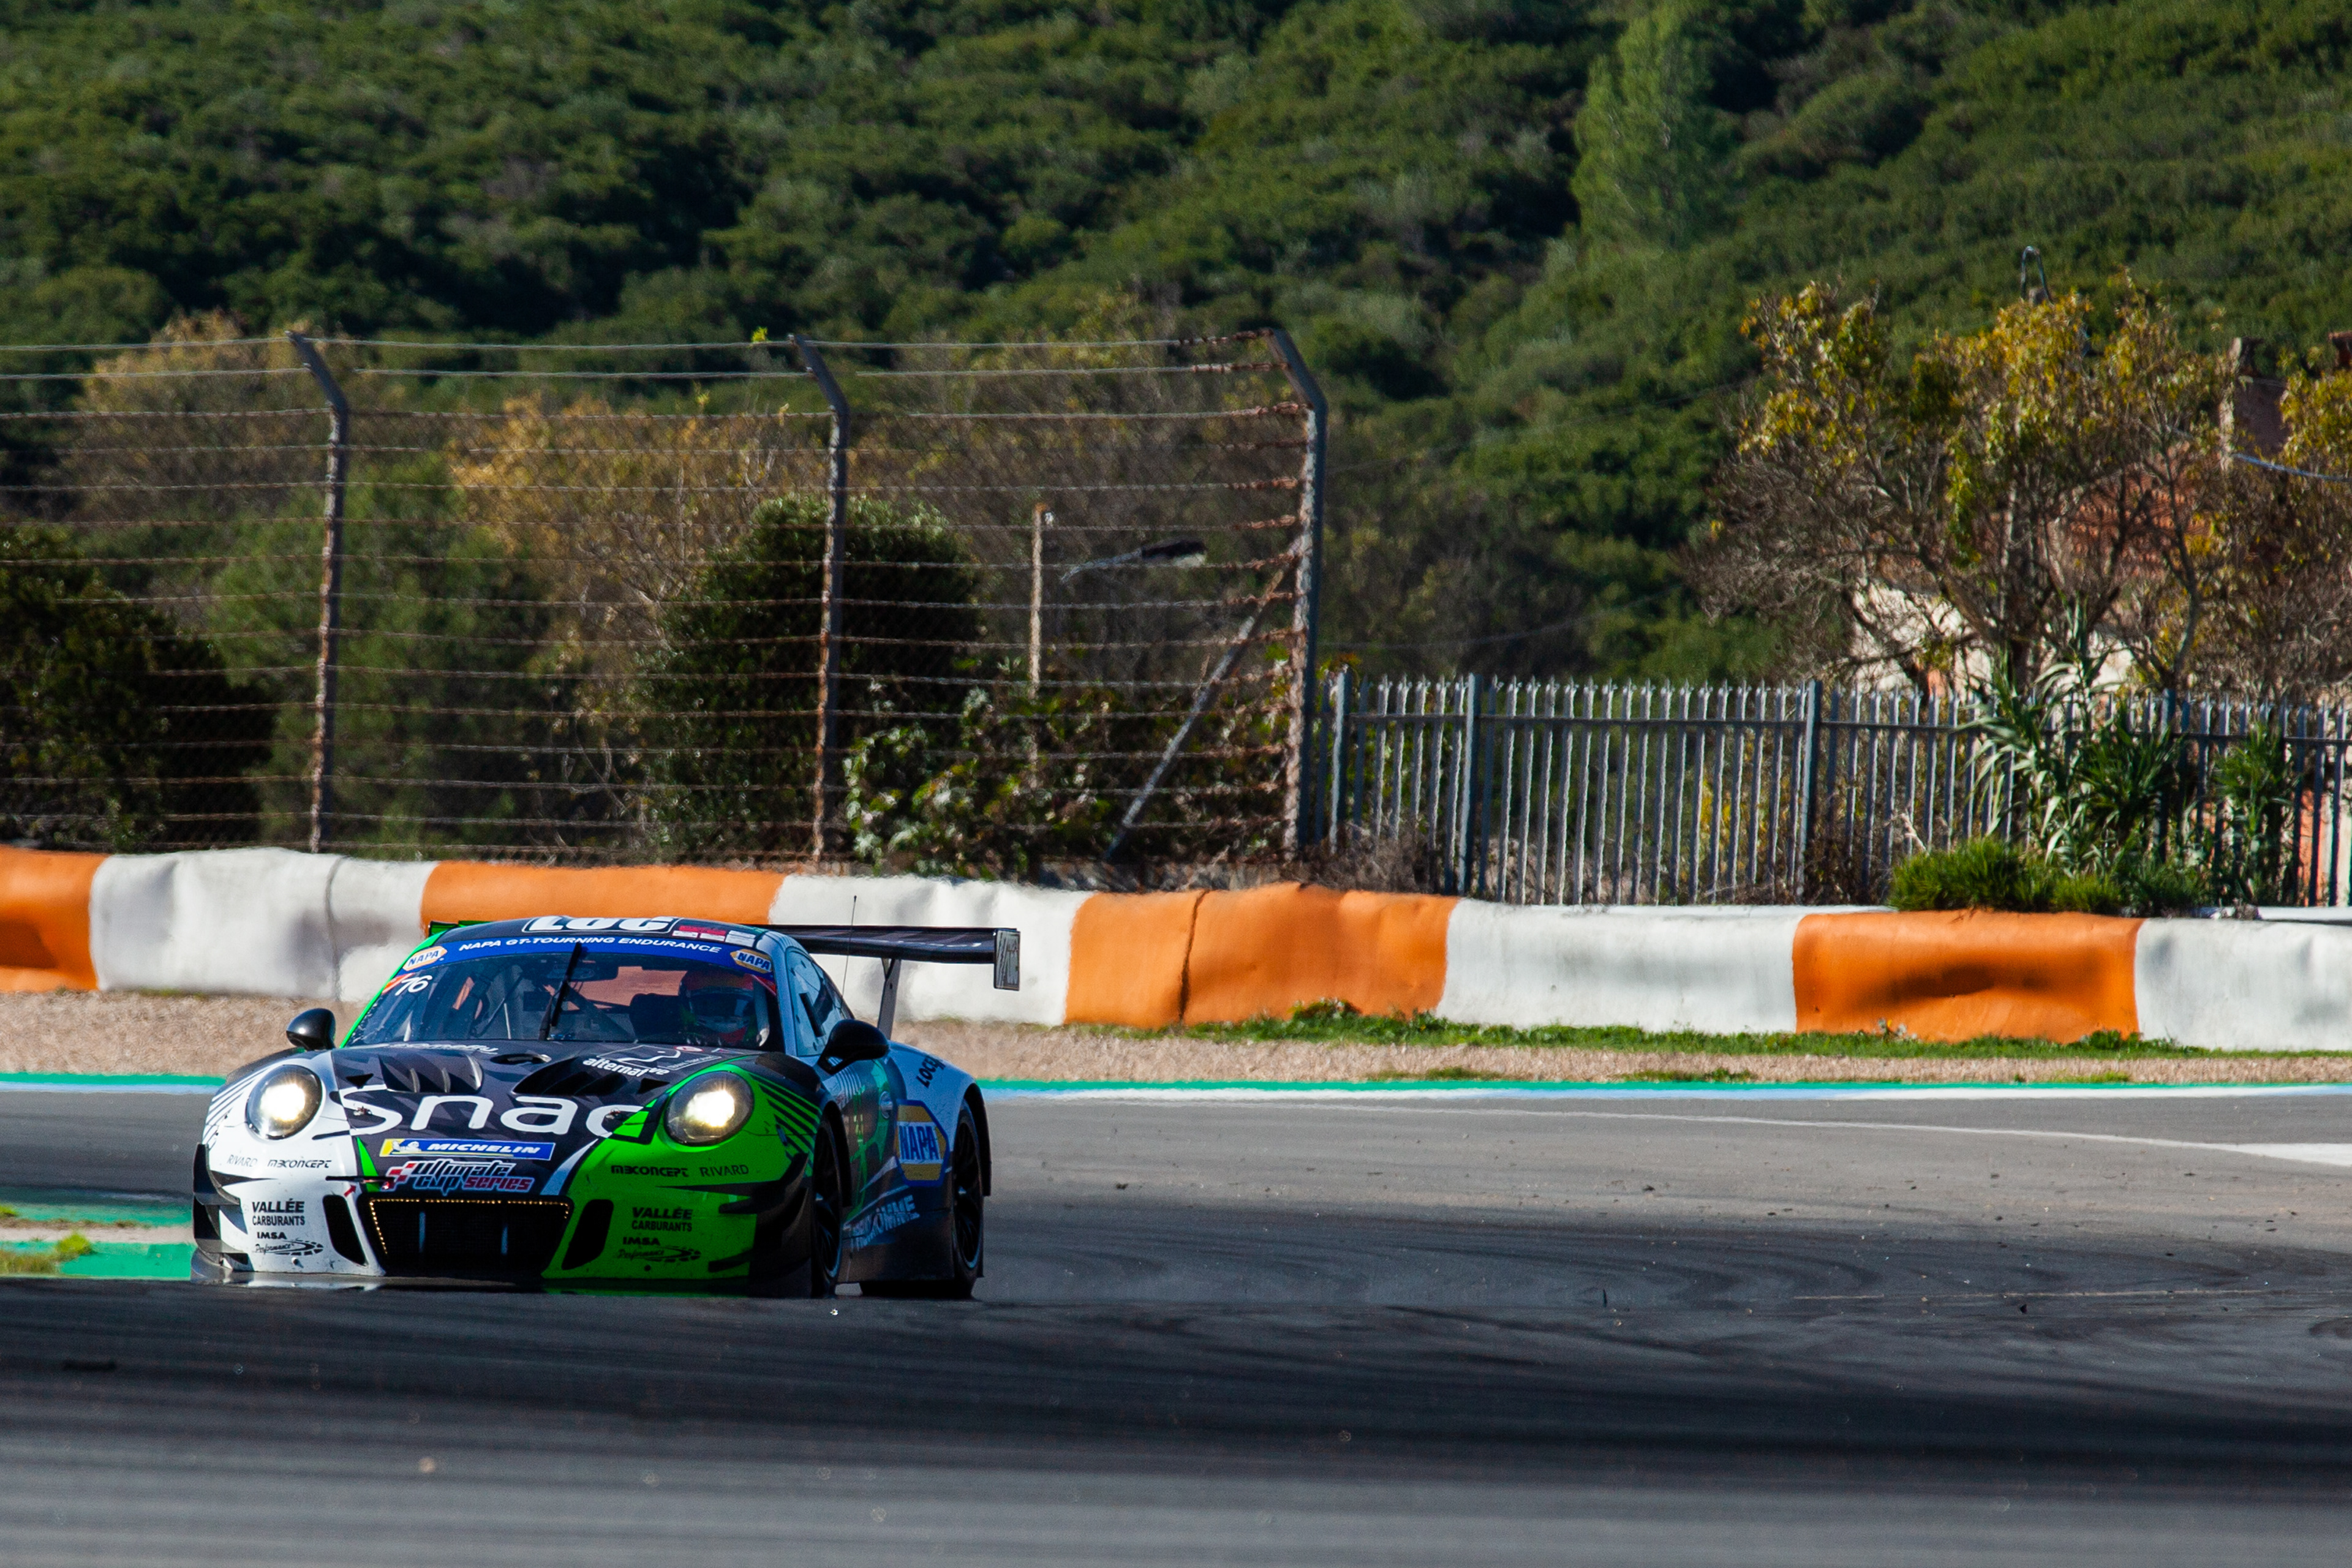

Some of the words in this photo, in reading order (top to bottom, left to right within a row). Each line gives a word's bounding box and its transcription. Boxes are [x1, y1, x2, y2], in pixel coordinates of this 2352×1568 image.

[459, 940, 501, 951] NAPA
[618, 938, 722, 953] ENDURANCE
[407, 950, 440, 967] NAPA
[737, 951, 771, 971] NAPA
[394, 975, 432, 996] 76
[582, 1057, 670, 1077] alternatve
[428, 1142, 541, 1154] MICHELIN
[899, 1125, 940, 1160] NAPA
[227, 1154, 258, 1167] RIVARD
[699, 1164, 749, 1177] RIVARD
[252, 1198, 305, 1213] VALLÉE
[252, 1215, 306, 1226] CARBURANTS
[632, 1207, 693, 1220] VALLÉE
[631, 1220, 693, 1232] CARBURANTS
[622, 1237, 661, 1246] IMSA
